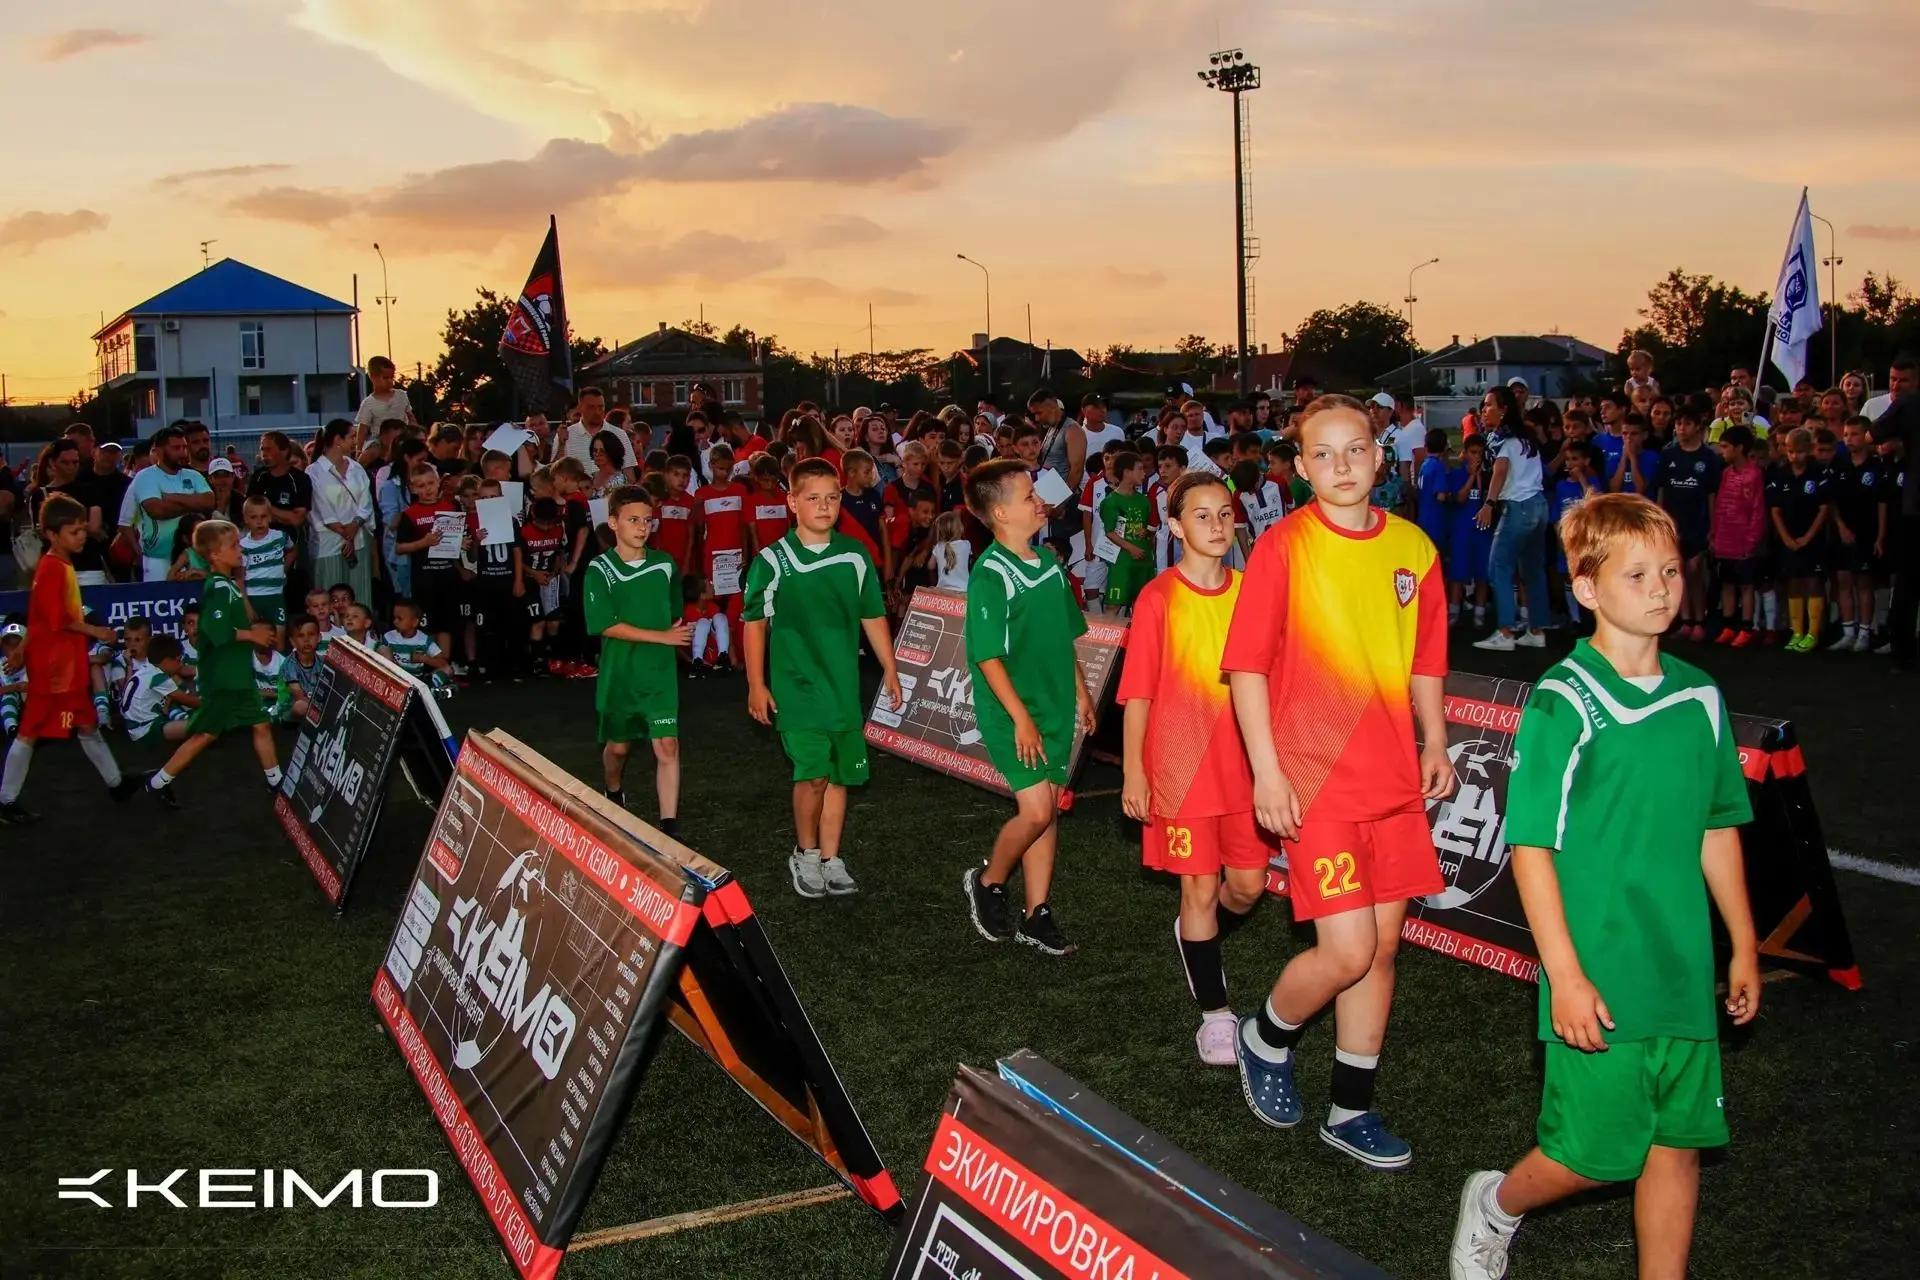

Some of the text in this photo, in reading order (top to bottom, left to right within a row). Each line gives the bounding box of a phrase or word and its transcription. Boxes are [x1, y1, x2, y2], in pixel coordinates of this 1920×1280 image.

[528, 603, 540, 616] 17
[1455, 703, 1496, 728] «ПОД
[1498, 709, 1520, 729] КЛ
[316, 730, 365, 809] KEIMO
[894, 734, 937, 761] ЭКИПИРОВКА
[936, 751, 974, 774] КОМАНДЫ
[460, 742, 501, 789] ЭКИПИРОВКА
[494, 772, 532, 816] КОМАНДЫ
[527, 798, 552, 834] «ПОД
[547, 812, 579, 853] КЛЮЧ»
[574, 834, 591, 863] ОТ
[585, 843, 620, 887] KEIMO
[626, 875, 675, 932] ЭКИПИР
[1166, 825, 1192, 859] 23
[1313, 851, 1361, 899] 22
[1439, 860, 1458, 876] НТР
[1401, 920, 1460, 956] МАНДЫ
[1462, 943, 1506, 973] «ПОД
[457, 903, 576, 1080] KEIMO
[375, 975, 395, 1016] KEIMO
[395, 1010, 433, 1079] ЭКИПИРОВКА
[425, 1064, 461, 1132] КОМАНДЫ
[452, 1115, 477, 1166] «ПОД
[471, 1144, 500, 1201] КЛЮЧ»
[493, 1185, 512, 1226] ОТ
[504, 1205, 536, 1266] KEIMO
[938, 1130, 1136, 1280] ЭКИПИРОВКА
